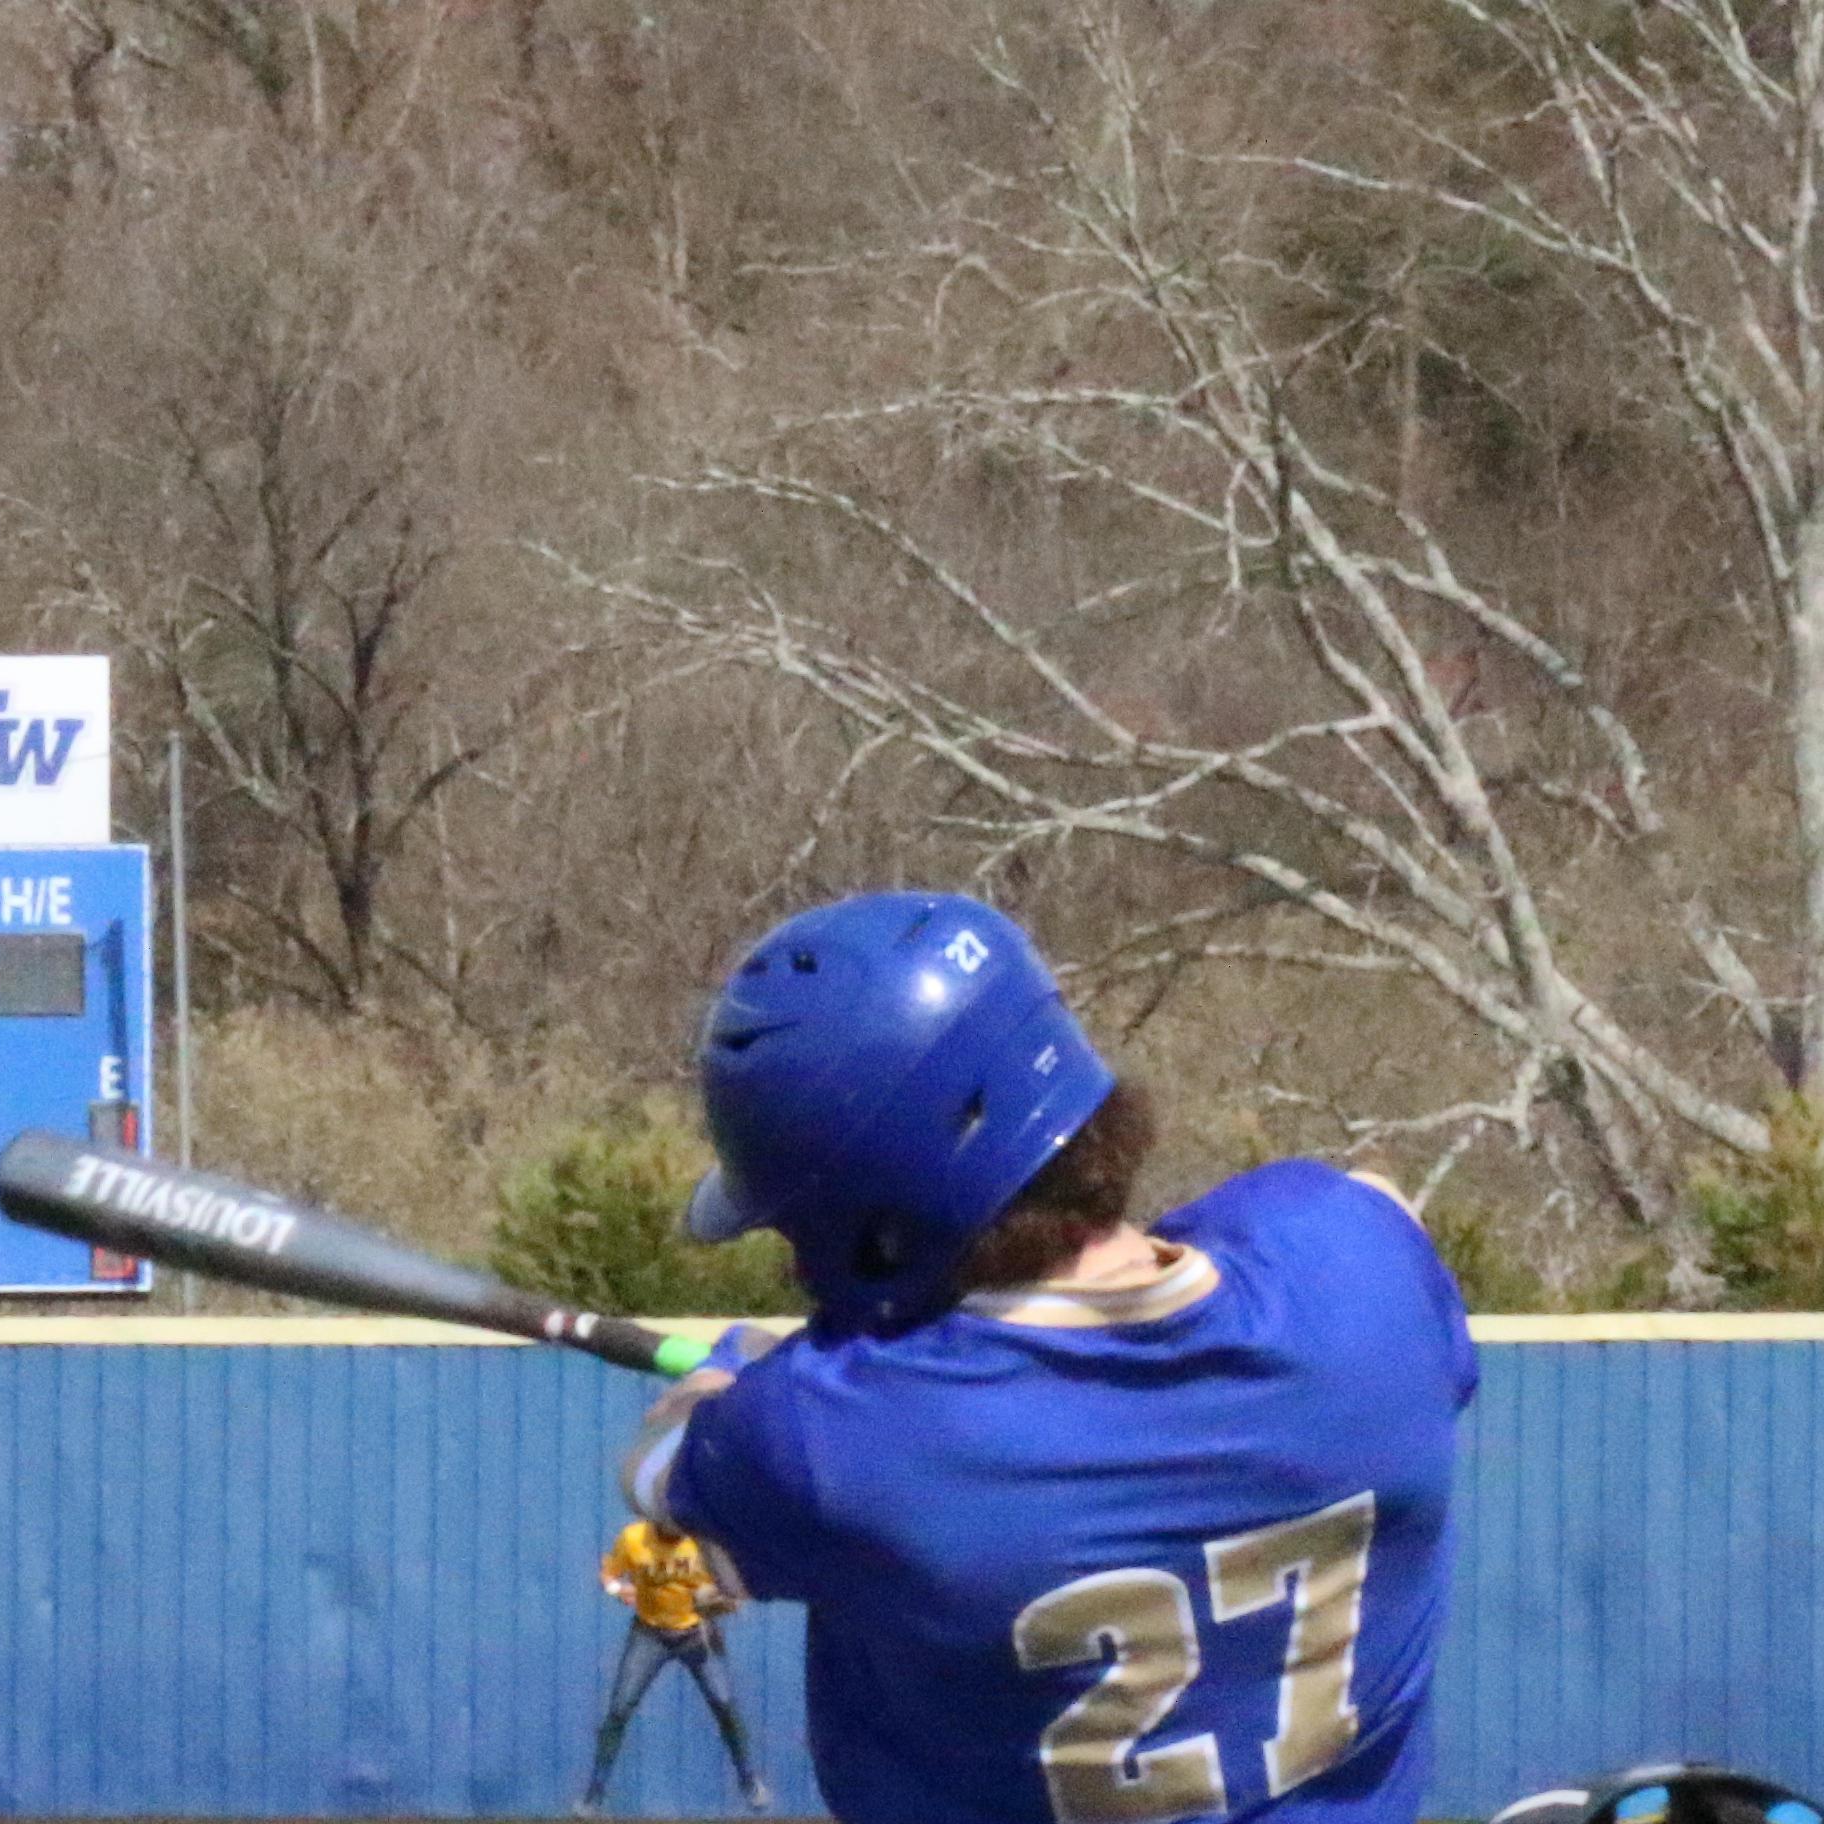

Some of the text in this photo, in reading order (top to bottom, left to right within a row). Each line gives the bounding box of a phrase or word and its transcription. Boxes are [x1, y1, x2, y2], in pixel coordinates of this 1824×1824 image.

[1, 877, 71, 927] H/E
[944, 930, 989, 973] 27
[65, 1155, 296, 1254] LOUISVILLE
